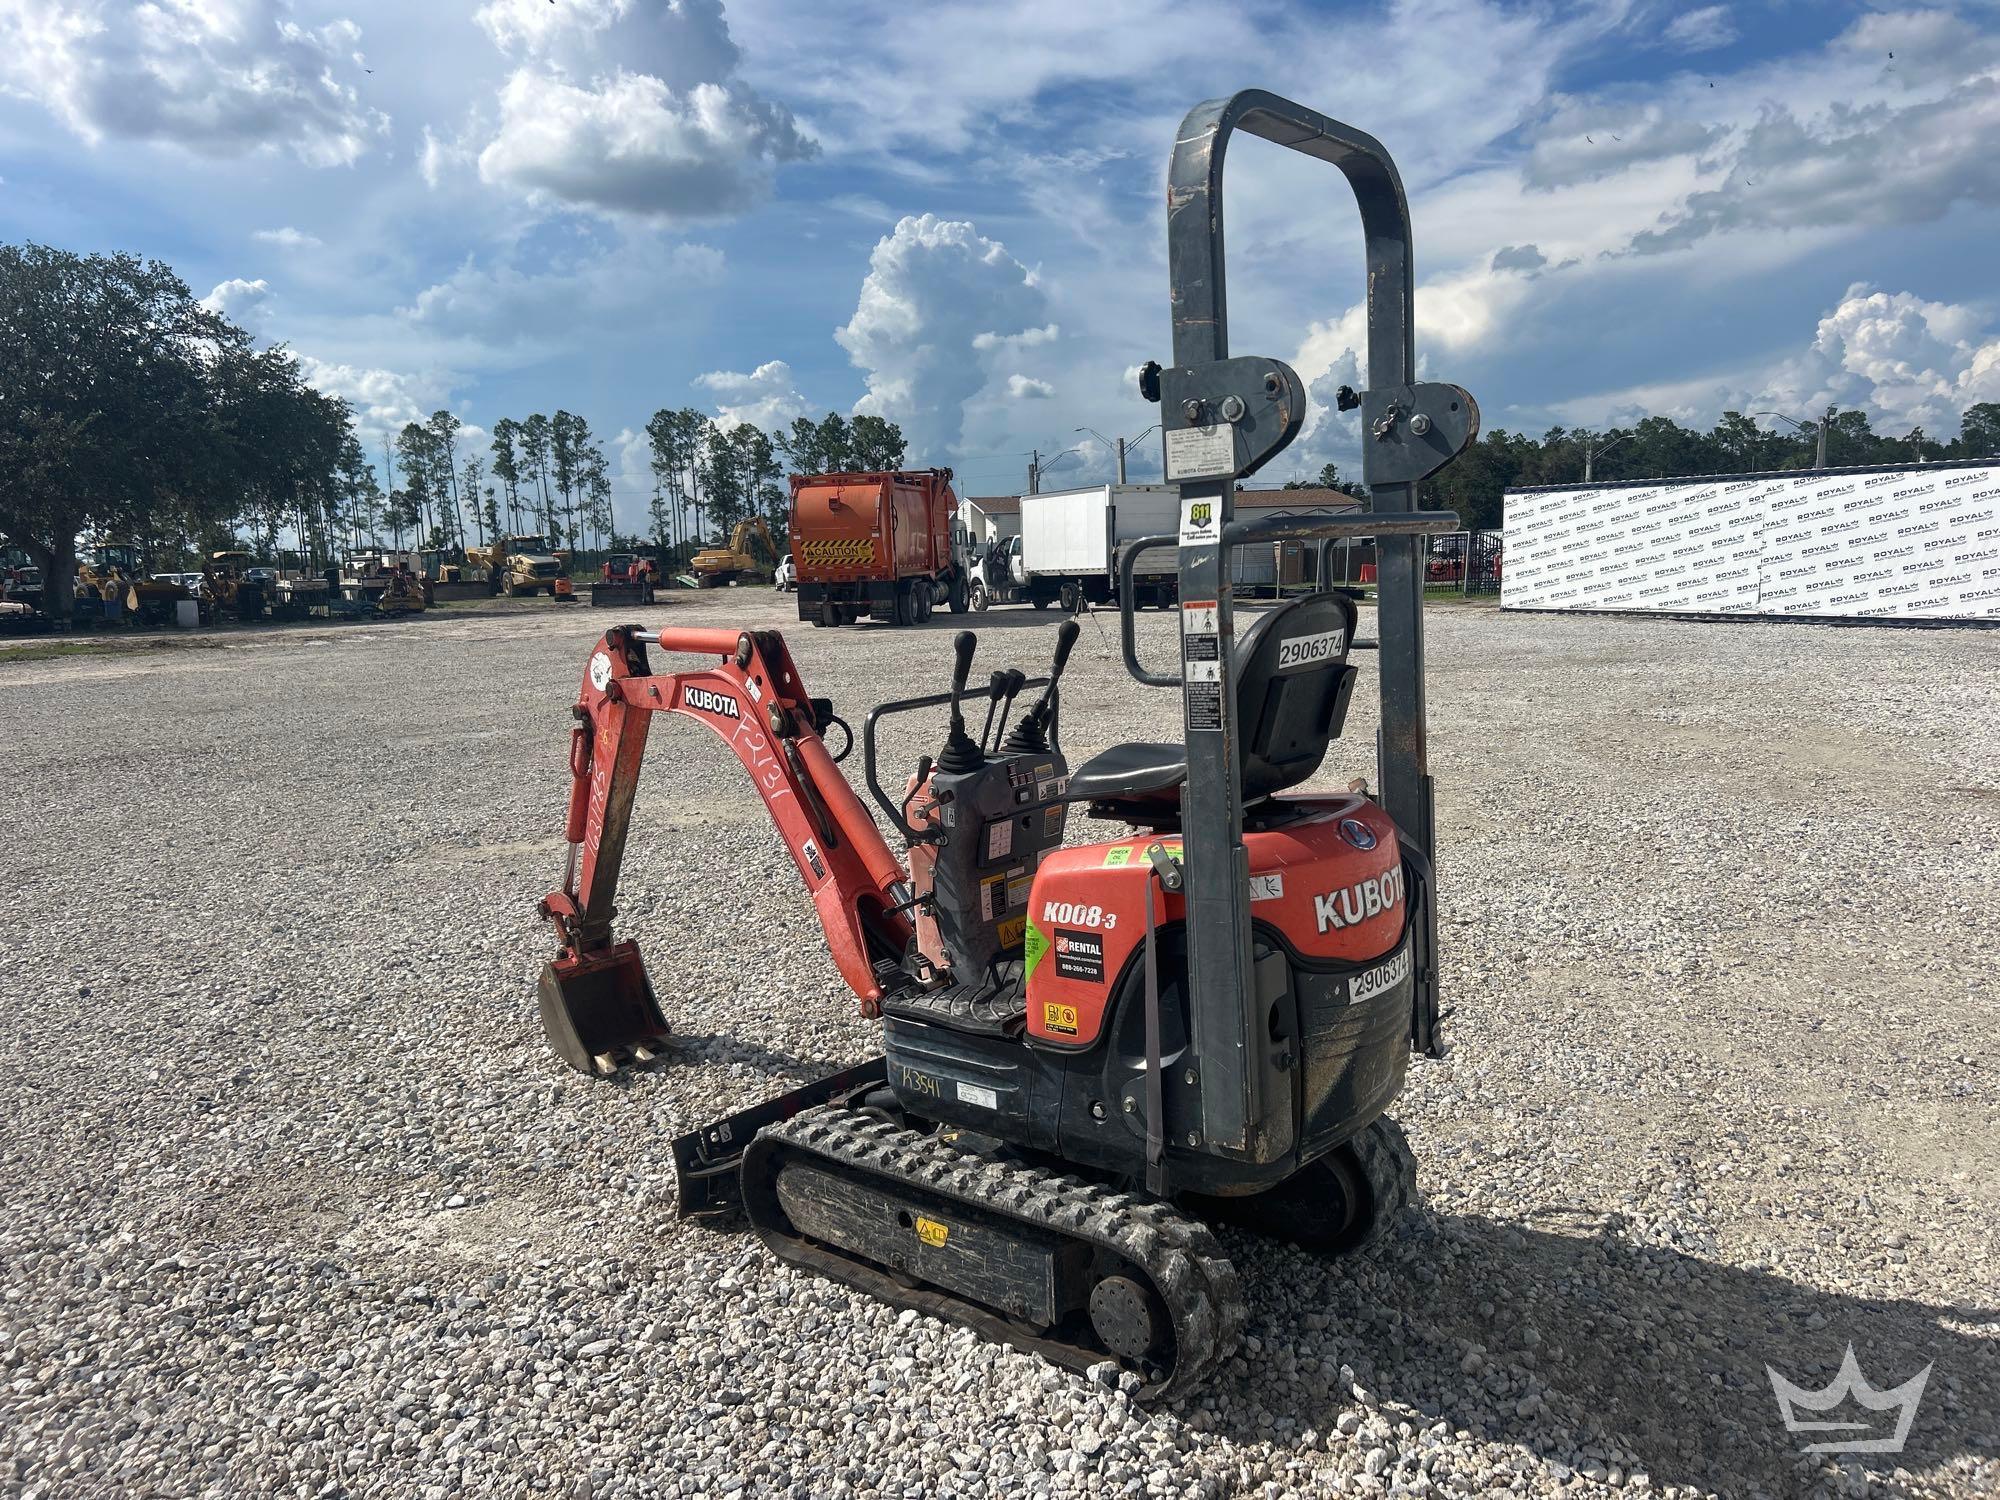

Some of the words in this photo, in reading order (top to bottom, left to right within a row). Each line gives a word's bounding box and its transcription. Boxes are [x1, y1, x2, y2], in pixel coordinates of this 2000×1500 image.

[1865, 475, 1896, 486] ROYAL
[1945, 475, 1979, 486] ROYAL
[1725, 482, 1751, 492] ROYAL
[1573, 492, 1595, 501] ROYAL
[1817, 487, 1847, 497] ROYAL
[1894, 487, 1926, 498] ROYAL
[1628, 493, 1651, 501] ROYAL
[1685, 493, 1710, 502] ROYAL
[1540, 502, 1561, 510] ROYAL
[1593, 503, 1615, 511] ROYAL
[1647, 504, 1670, 512] ROYAL
[1772, 499, 1800, 508] ROYAL
[1844, 499, 1875, 509] ROYAL
[1920, 500, 1953, 510] ROYAL
[1191, 503, 1211, 520] 811
[1708, 504, 1734, 513] ROYAL
[1559, 512, 1580, 520] ROYAL
[1611, 514, 1633, 522] ROYAL
[1669, 514, 1693, 523] ROYAL
[1798, 510, 1826, 520] ROYAL
[1869, 512, 1900, 522] ROYAL
[1950, 513, 1984, 523] ROYAL
[1729, 516, 1755, 525] ROYAL
[1576, 523, 1598, 531] ROYAL
[1632, 524, 1655, 532] ROYAL
[1689, 526, 1714, 534] ROYAL
[1821, 523, 1851, 532] ROYAL
[1898, 524, 1930, 534] ROYAL
[1596, 533, 1618, 541] ROYAL
[1651, 536, 1675, 544] ROYAL
[1712, 537, 1738, 546] ROYAL
[1776, 533, 1804, 542] ROYAL
[1849, 535, 1879, 545] ROYAL
[1924, 538, 1957, 548] ROYAL
[815, 547, 858, 556] CAUTION
[1614, 545, 1637, 553] ROYAL
[1673, 547, 1697, 555] ROYAL
[1733, 549, 1759, 558] ROYAL
[1802, 545, 1831, 554] ROYAL
[1874, 549, 1905, 558] ROYAL
[1636, 556, 1659, 564] ROYAL
[1955, 551, 1989, 561] ROYAL
[1693, 559, 1718, 567] ROYAL
[1826, 558, 1856, 568] ROYAL
[1903, 562, 1935, 571] ROYAL
[1716, 570, 1742, 578] ROYAL
[1780, 568, 1808, 577] ROYAL
[1853, 571, 1884, 580] ROYAL
[1806, 581, 1835, 589] ROYAL
[1929, 576, 1962, 585] ROYAL
[1762, 589, 1789, 598] ROYAL
[1879, 585, 1910, 594] ROYAL
[1830, 594, 1860, 603] ROYAL
[1960, 590, 1994, 599] ROYAL
[1784, 603, 1813, 611] ROYAL
[1907, 599, 1940, 608] ROYAL
[1858, 608, 1888, 616] ROYAL
[1280, 634, 1343, 665] 2906374
[685, 687, 739, 718] KUBOTA
[1043, 901, 1117, 930] K008-3
[1068, 940, 1102, 956] RENTAL
[1354, 957, 1408, 997] 2906374
[902, 1066, 941, 1098] K3541
